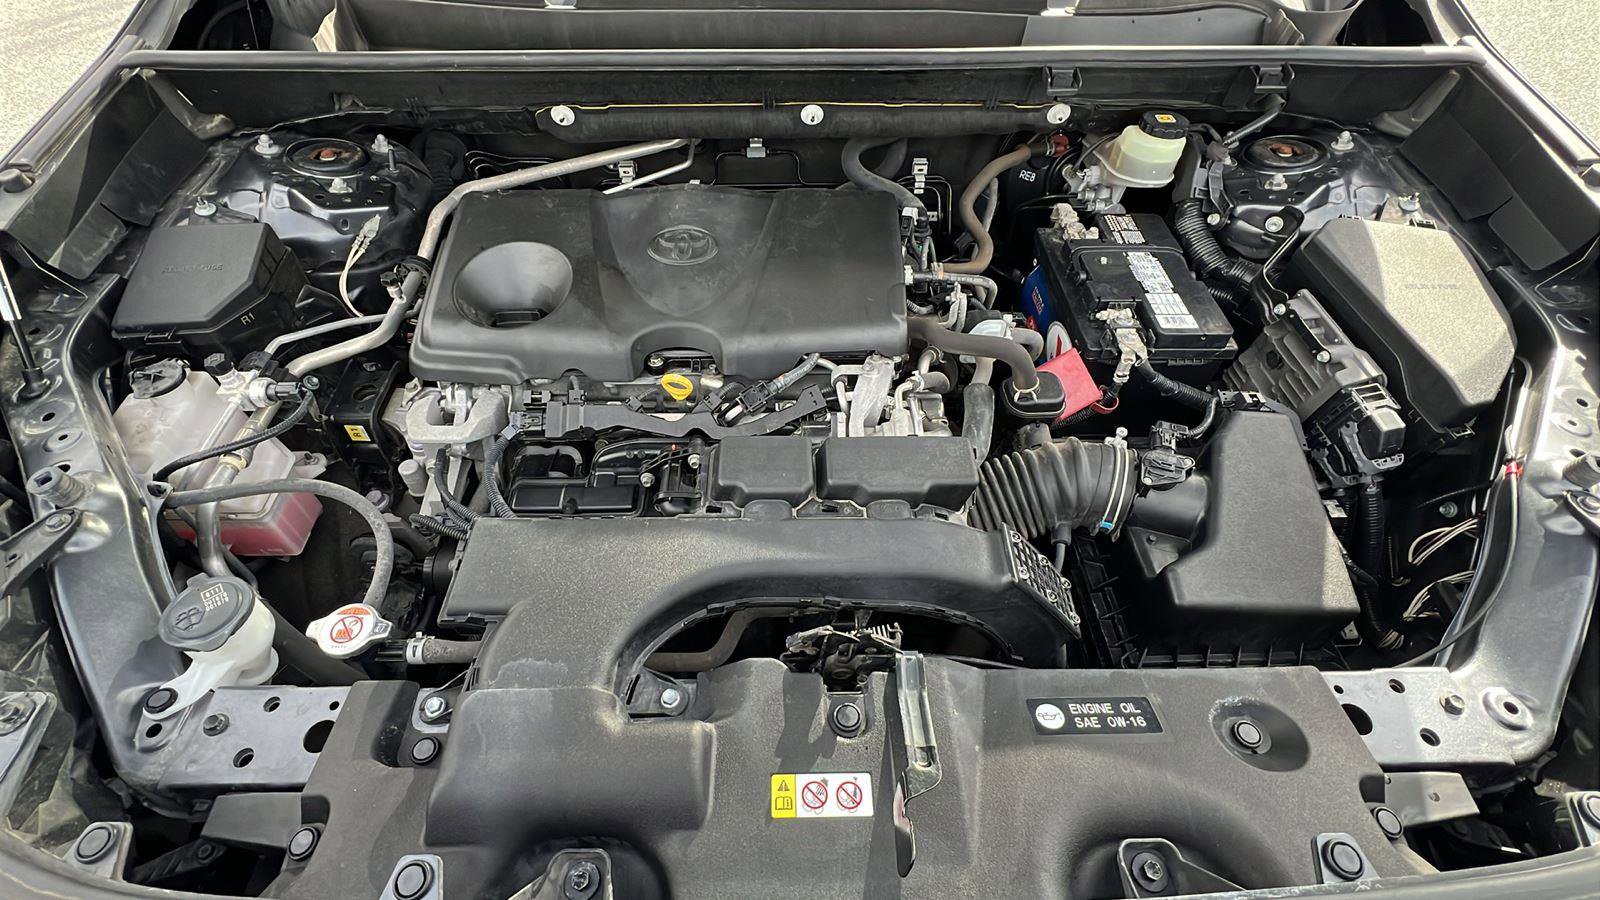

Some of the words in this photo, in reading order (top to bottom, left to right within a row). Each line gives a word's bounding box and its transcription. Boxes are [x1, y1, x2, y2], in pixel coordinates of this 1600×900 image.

[1018, 169, 1036, 182] RE8
[241, 312, 256, 326] R1
[1068, 702, 1114, 715] ENGINE
[1119, 702, 1142, 714] OIL
[1074, 716, 1102, 728] SAE
[1106, 716, 1147, 728] 0W-16
